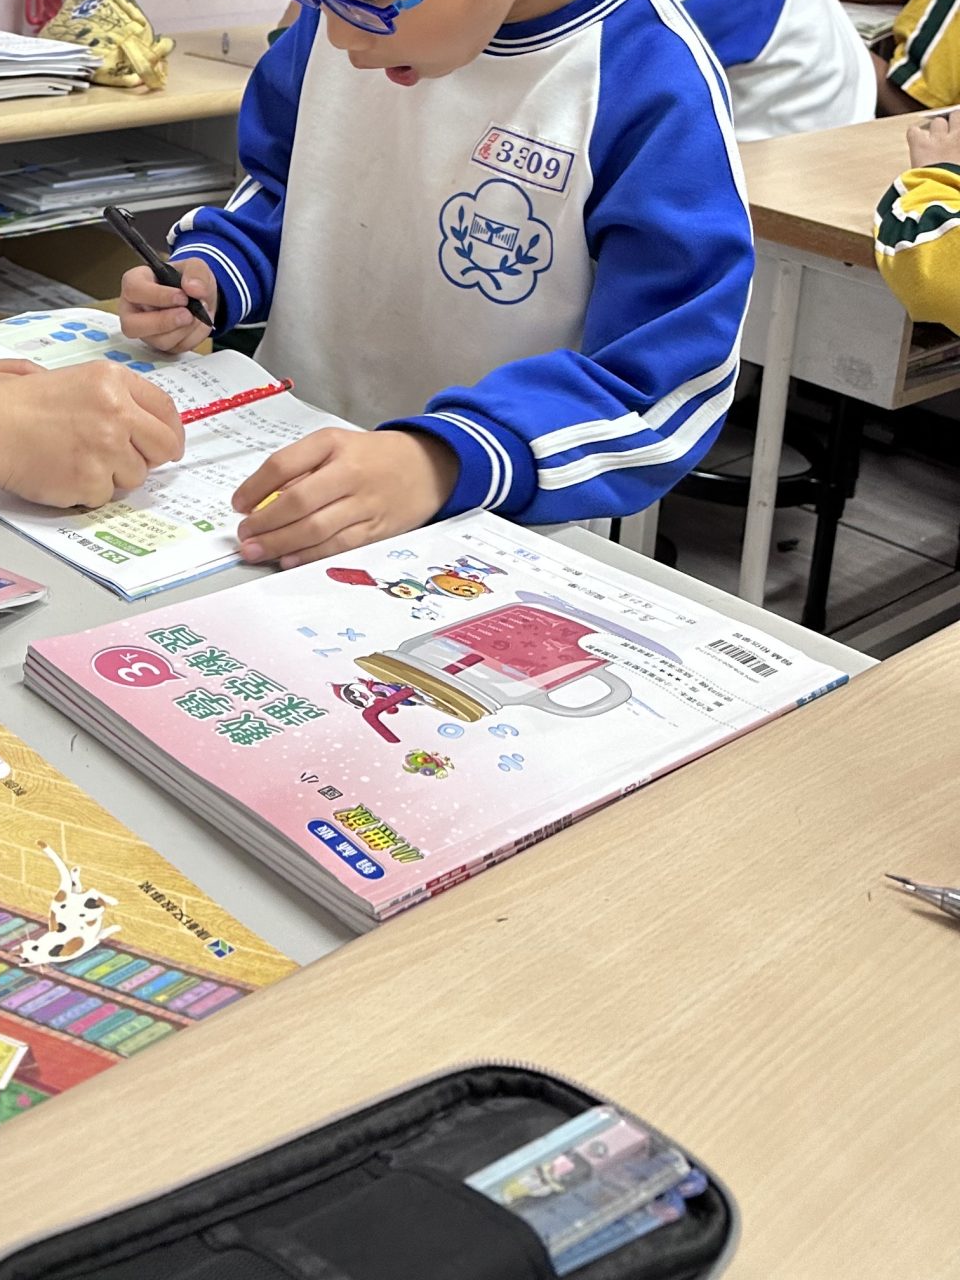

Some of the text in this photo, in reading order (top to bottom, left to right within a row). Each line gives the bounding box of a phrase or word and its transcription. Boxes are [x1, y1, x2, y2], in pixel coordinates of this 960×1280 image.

[117, 662, 162, 682] 3
[146, 625, 326, 727] 課堂練習
[176, 689, 281, 745] 數學
[317, 825, 375, 874] 翰林版
[332, 804, 428, 863] 小無敵
